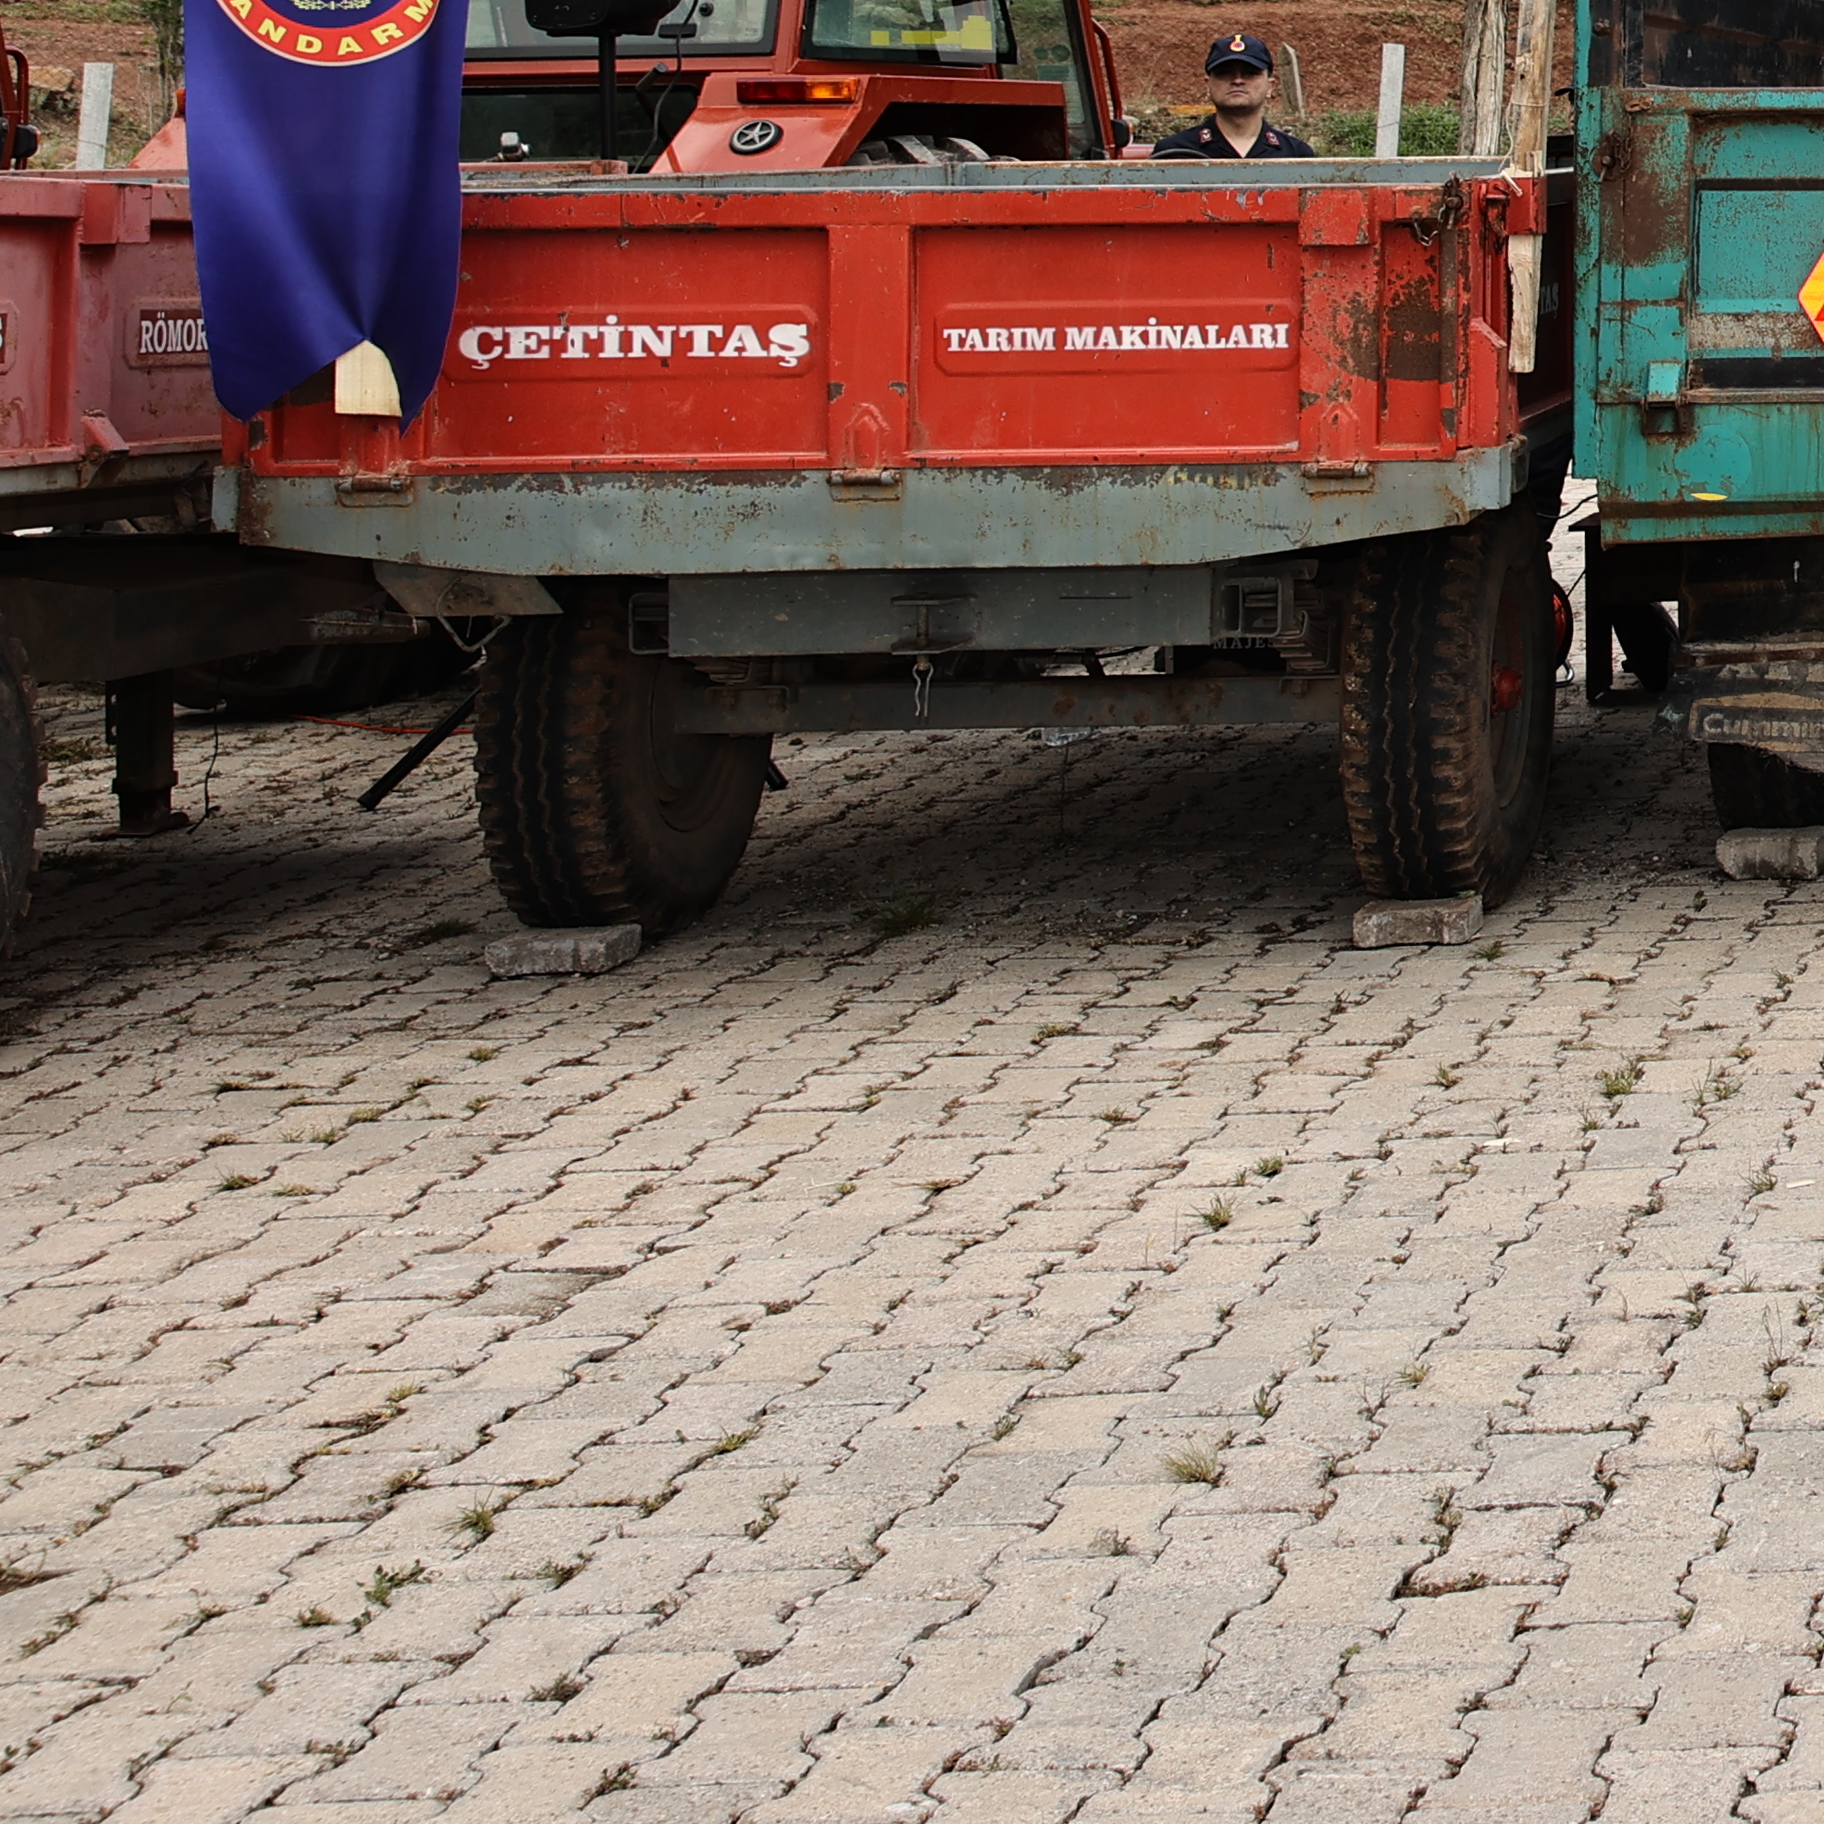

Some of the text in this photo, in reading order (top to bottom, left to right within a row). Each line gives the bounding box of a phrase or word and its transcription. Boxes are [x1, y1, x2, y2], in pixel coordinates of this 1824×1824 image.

[458, 314, 811, 370] ÇETİNTAŞ
[943, 317, 1290, 352] TARIM MAKİNALARI
